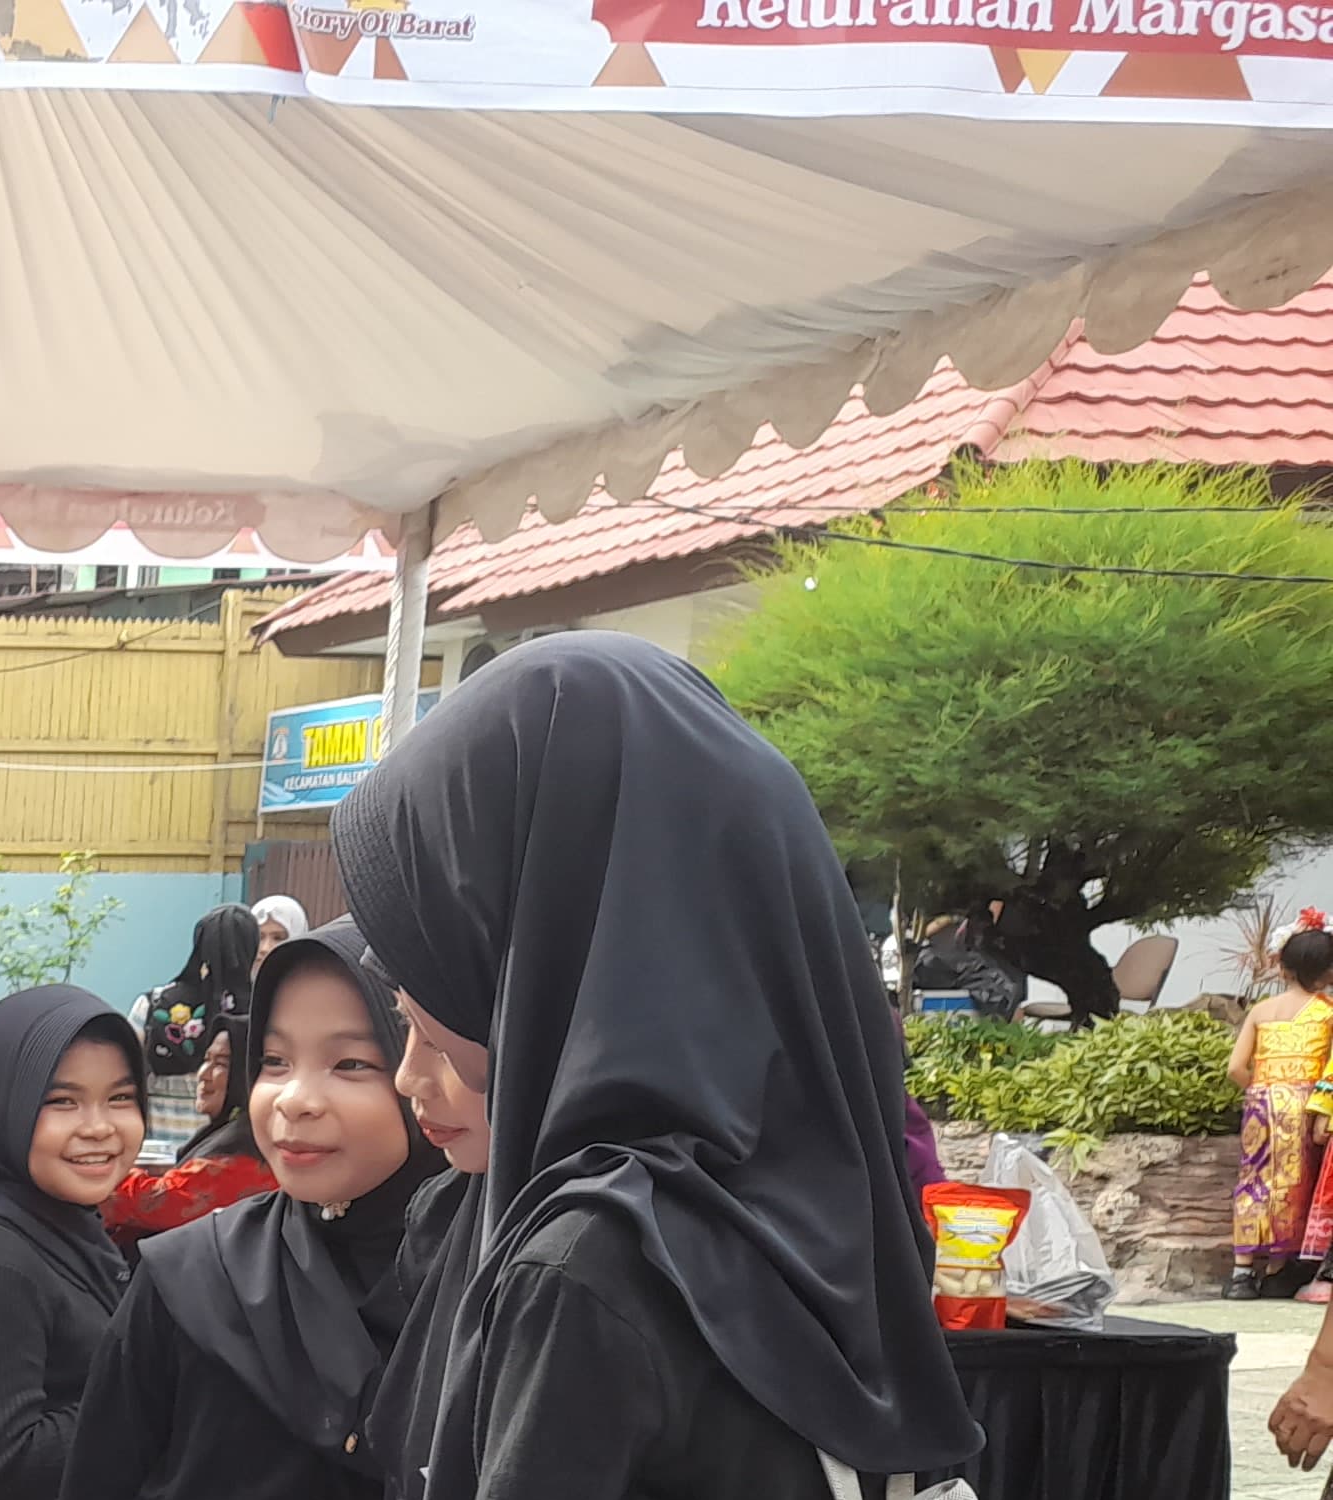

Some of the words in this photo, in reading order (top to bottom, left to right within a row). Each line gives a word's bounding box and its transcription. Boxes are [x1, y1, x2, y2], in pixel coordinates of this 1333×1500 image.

[360, 10, 393, 34] Of
[397, 13, 476, 38] Barat
[302, 718, 368, 770] TAMAN
